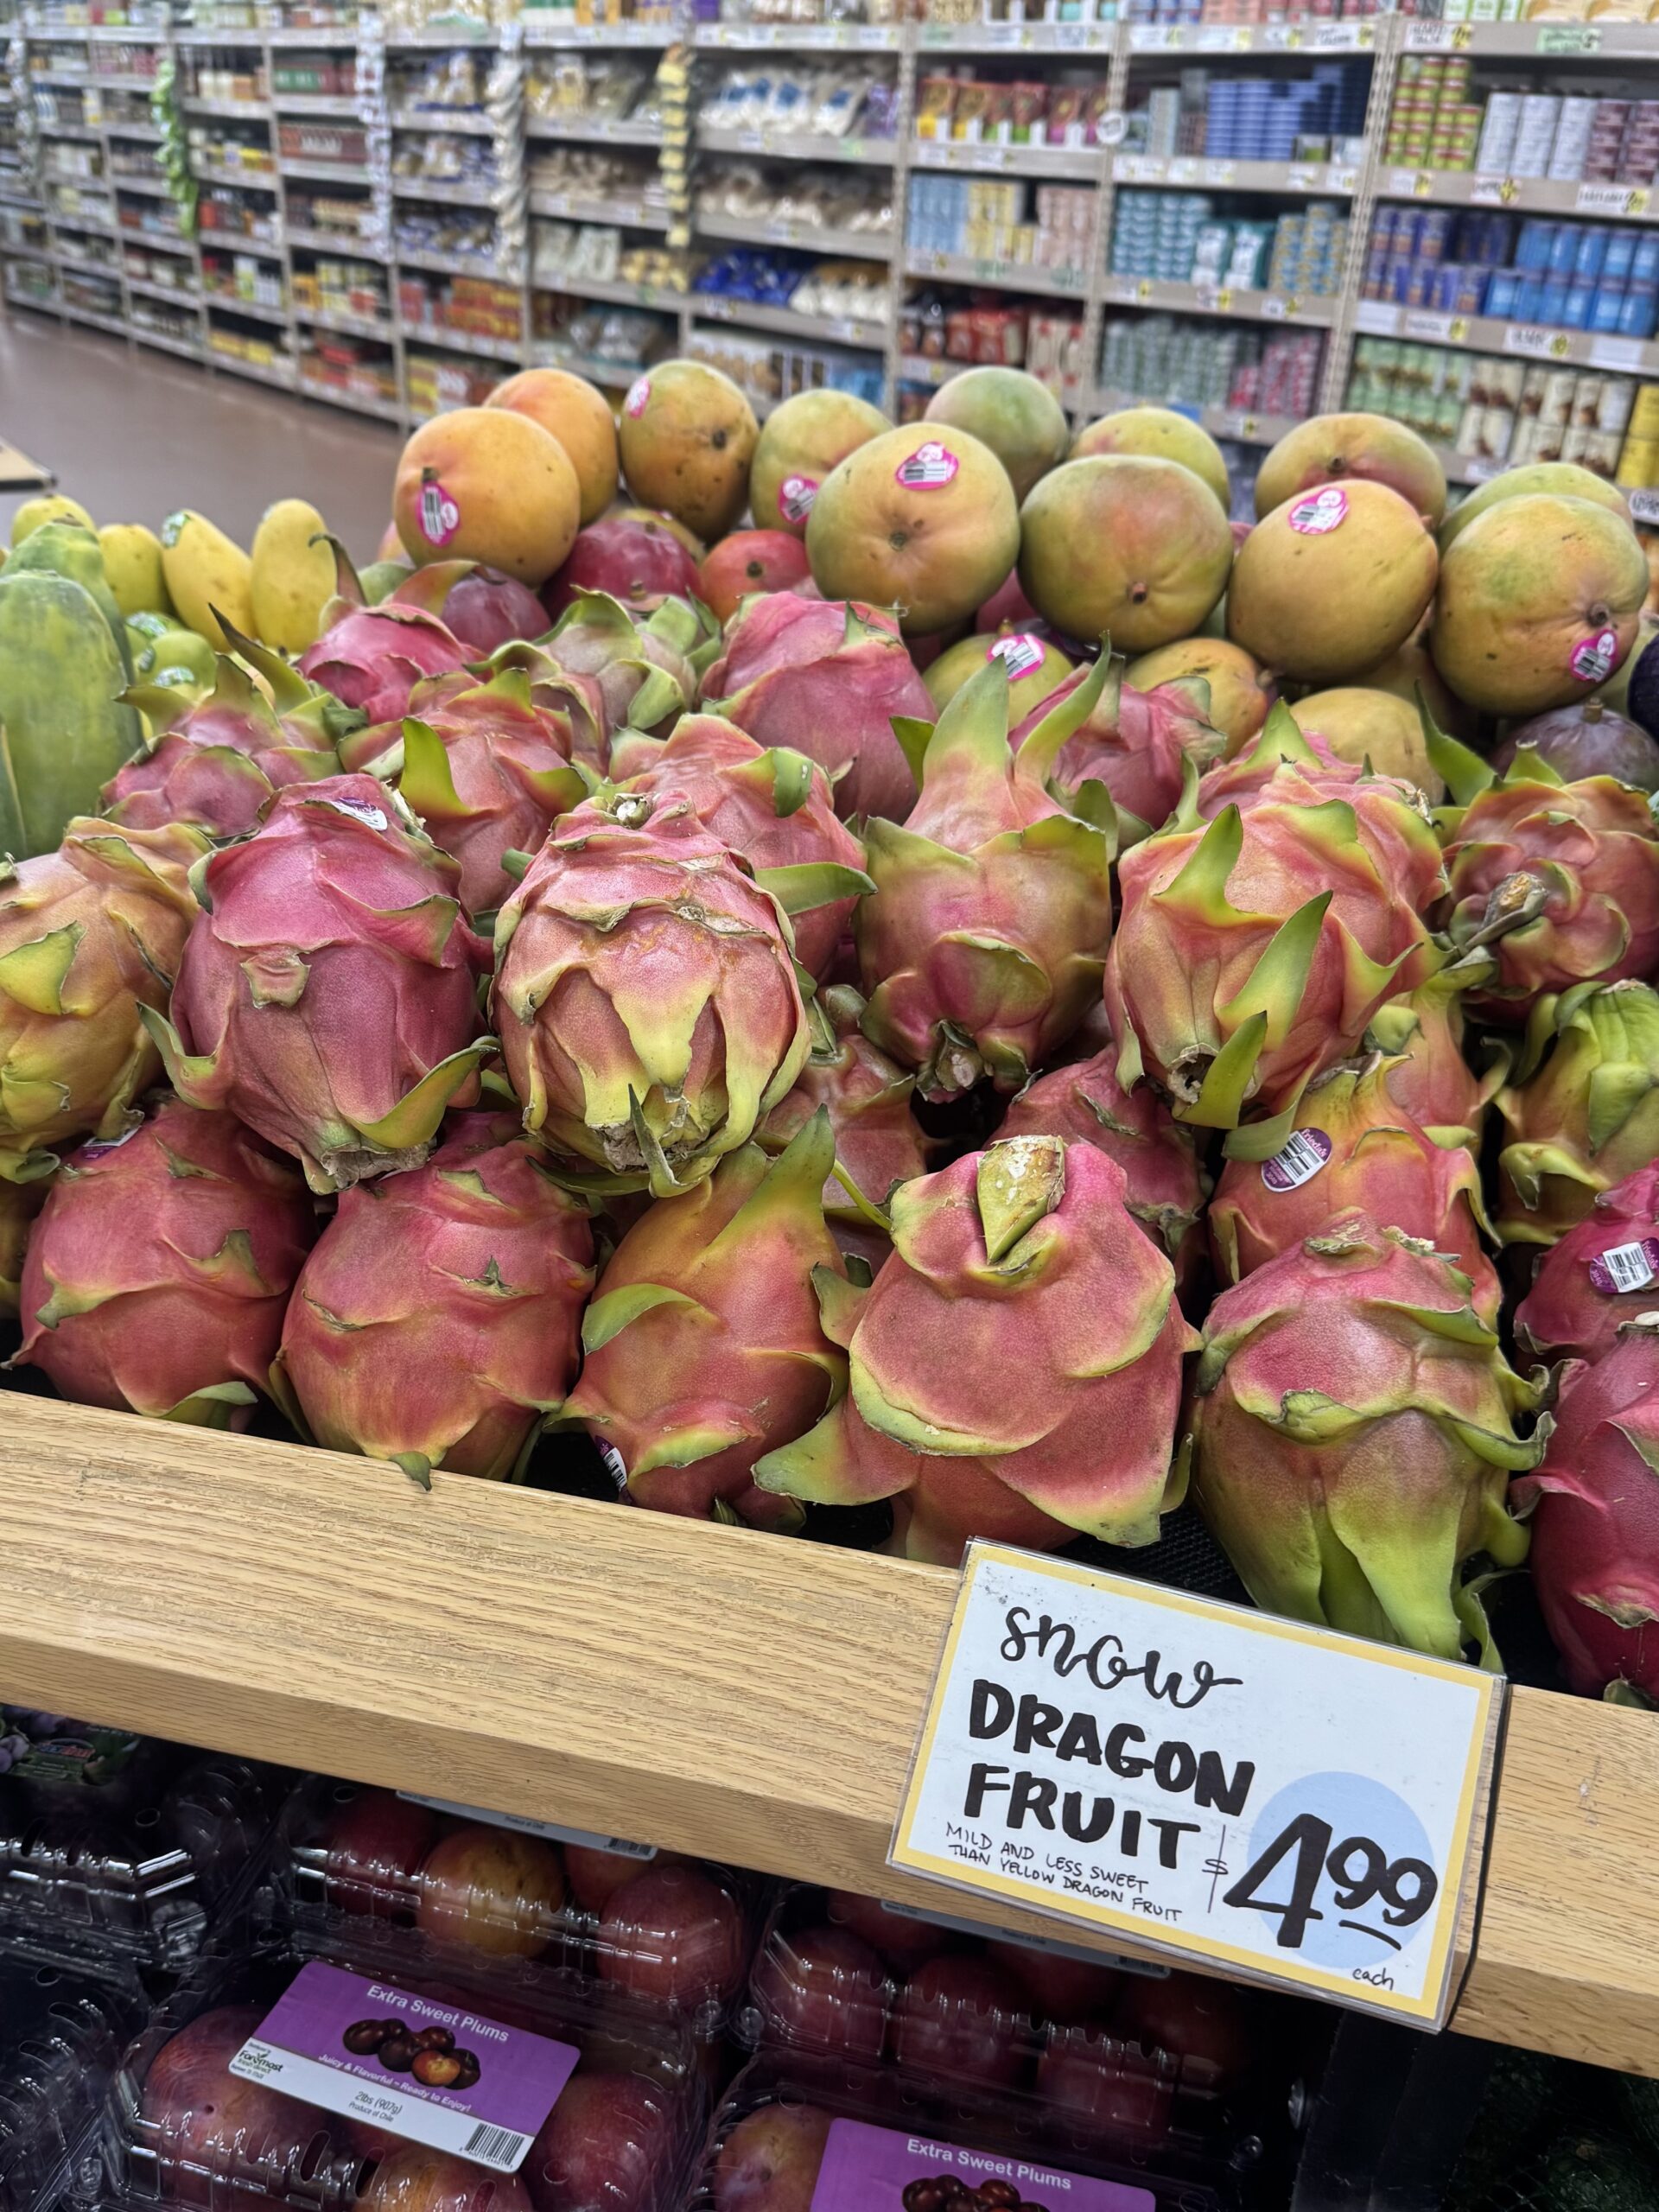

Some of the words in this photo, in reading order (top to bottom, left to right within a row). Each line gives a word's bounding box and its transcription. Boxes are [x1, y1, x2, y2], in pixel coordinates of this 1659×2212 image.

[1000, 1606, 1243, 1709] snow
[969, 1678, 1255, 1816] DRAGON
[963, 1763, 1201, 1870] FRUIT
[946, 1821, 993, 1850] MILD
[1001, 1841, 1035, 1859] AND
[1046, 1853, 1083, 1877] LESS
[1090, 1866, 1149, 1894] SWEET
[949, 1844, 991, 1866] THAN
[1000, 1859, 1055, 1884] YELLOW
[1063, 1876, 1122, 1903] DRAGON
[1132, 1897, 1183, 1922] FRUIT
[1352, 1967, 1395, 1990] each
[367, 1985, 408, 2009] Extra
[410, 1999, 460, 2025] Sweet
[461, 2016, 509, 2042] Plums
[318, 2054, 343, 2069] Juicy
[344, 2063, 352, 2071] &
[353, 2065, 394, 2085] Flavorful
[400, 2081, 431, 2099] Ready
[430, 2093, 441, 2102] to
[441, 2095, 472, 2113] Enjoy!
[354, 2091, 373, 2104] 2lbs
[907, 2139, 953, 2161] Extra
[957, 2151, 1013, 2177] Sweet
[1016, 2164, 1071, 2190] Plums
